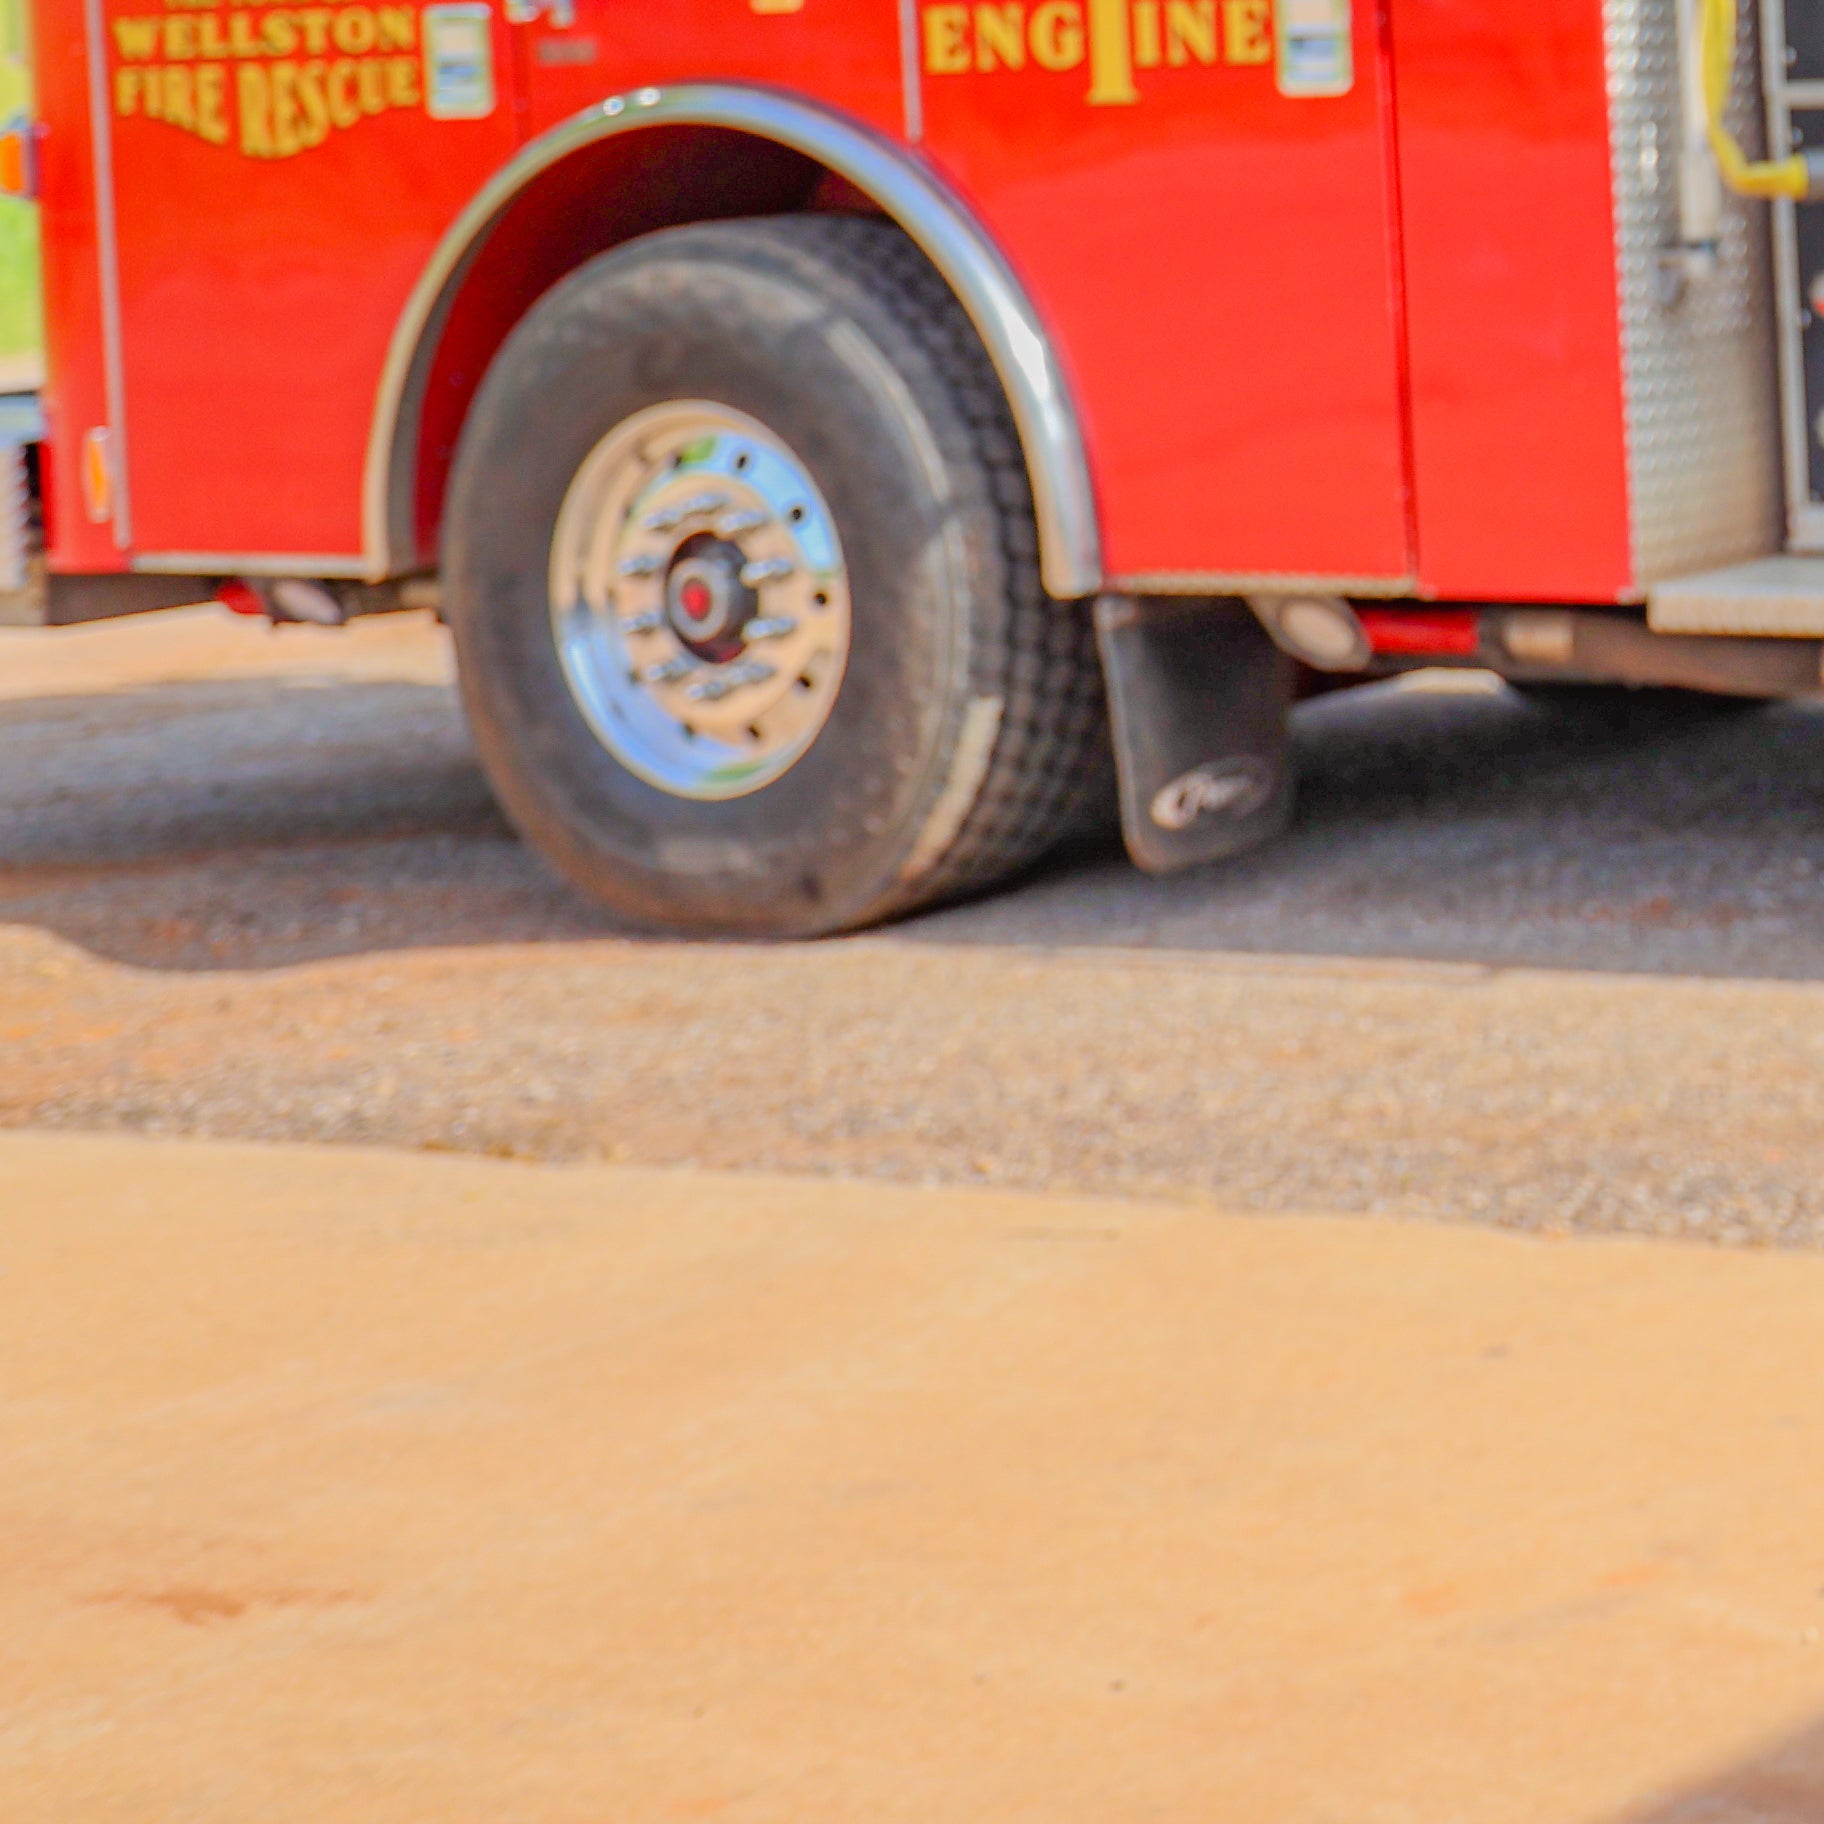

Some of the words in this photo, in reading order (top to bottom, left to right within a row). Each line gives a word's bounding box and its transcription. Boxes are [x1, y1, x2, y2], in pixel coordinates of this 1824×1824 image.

[113, 6, 415, 61] WELLSTON
[115, 61, 228, 145] FIRE
[236, 55, 420, 159] RESCUE
